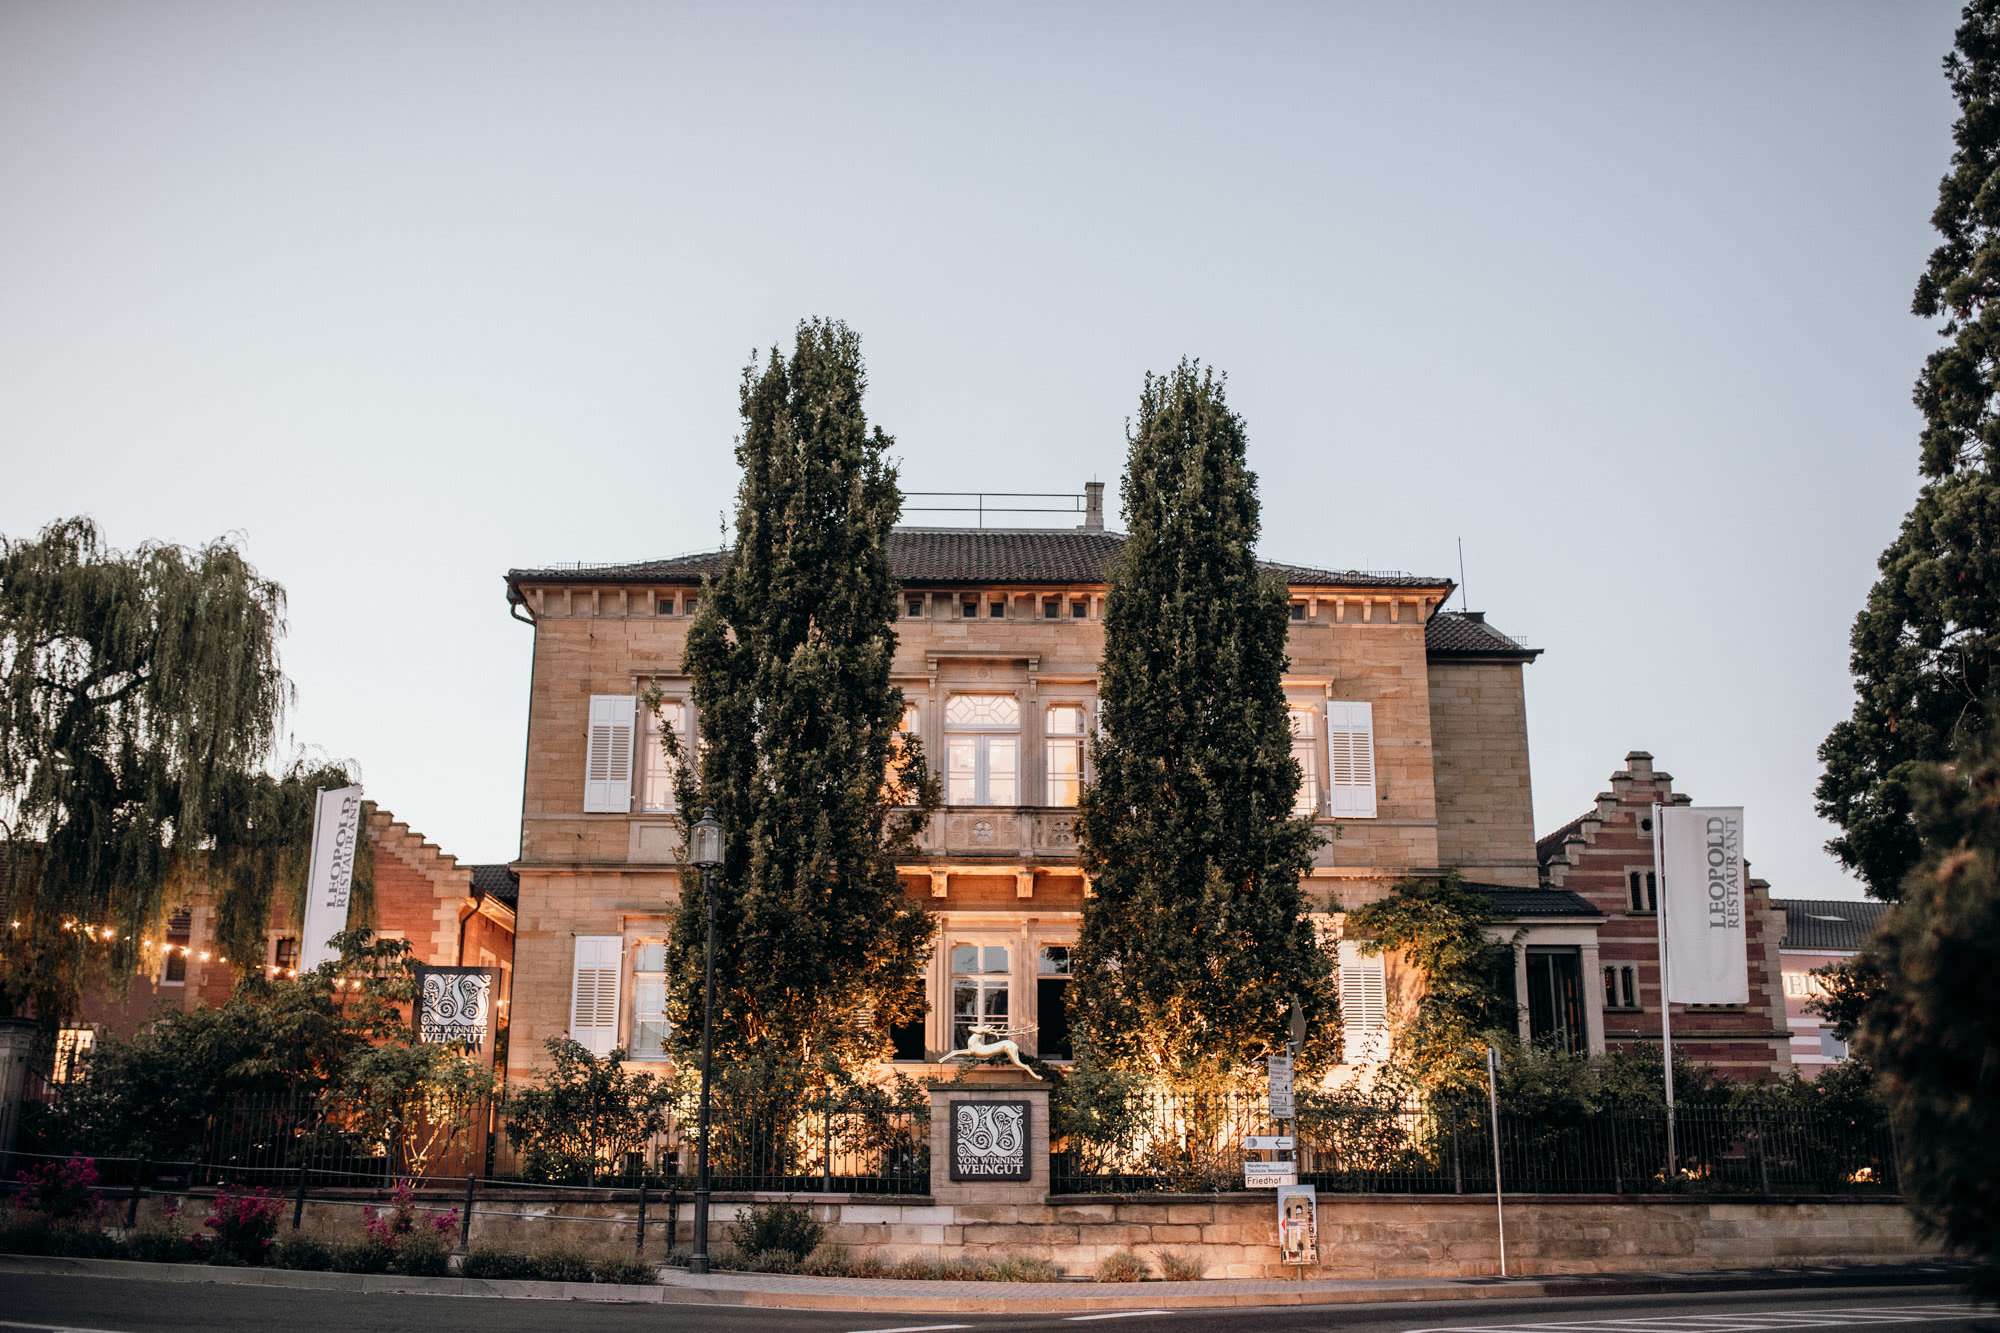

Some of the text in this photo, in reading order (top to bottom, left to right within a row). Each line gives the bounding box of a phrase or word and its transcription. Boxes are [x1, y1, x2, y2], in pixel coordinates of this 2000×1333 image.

[326, 796, 352, 909] LEOPOLD
[336, 796, 359, 909] RESTAURANT
[1706, 816, 1726, 929] LEOPOLD
[1725, 816, 1739, 930] RESTAURANT
[420, 1025, 488, 1034] VON WINNING
[957, 1156, 1024, 1164] VON WINNING
[957, 1164, 1024, 1175] WEINGUT
[1247, 1176, 1282, 1185] Friedhof
